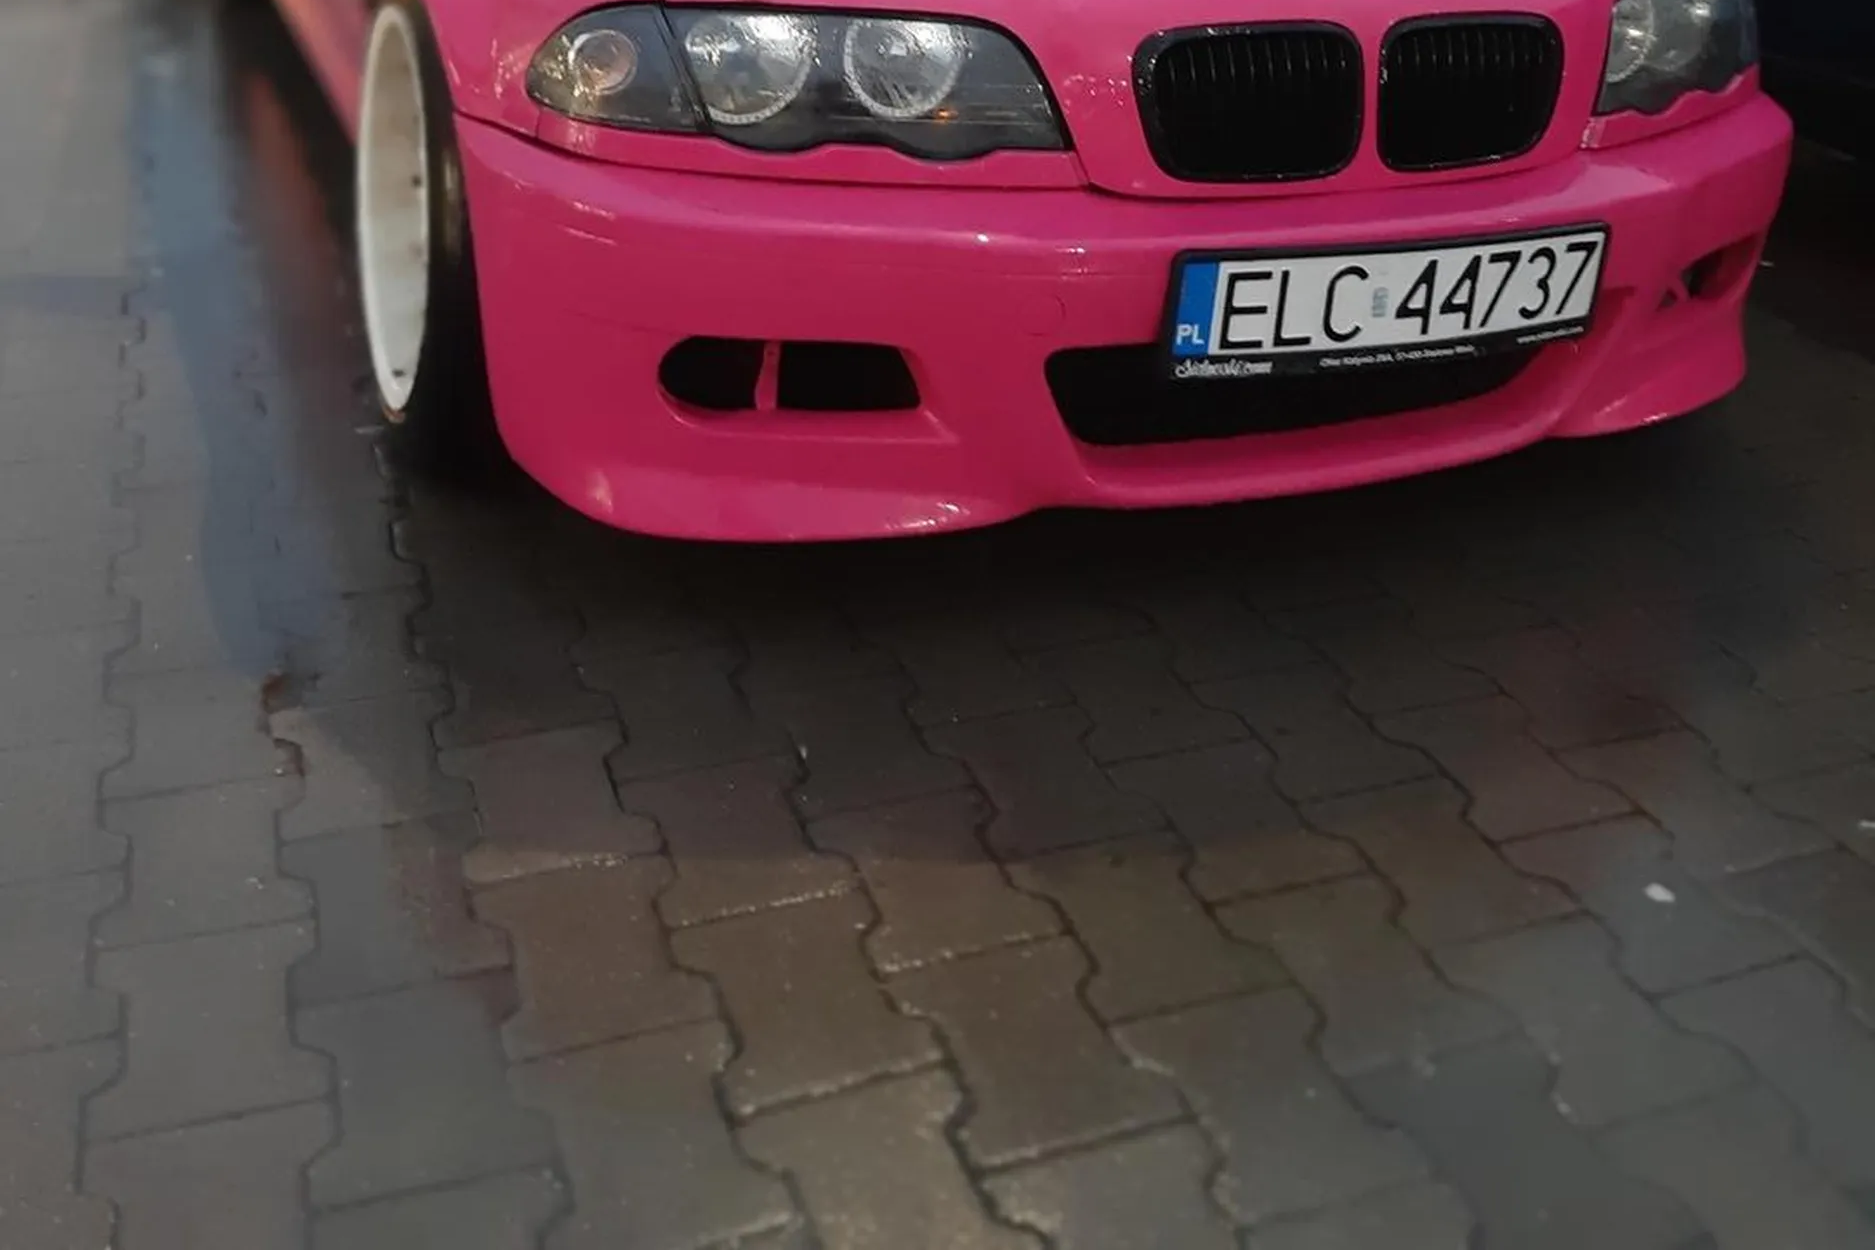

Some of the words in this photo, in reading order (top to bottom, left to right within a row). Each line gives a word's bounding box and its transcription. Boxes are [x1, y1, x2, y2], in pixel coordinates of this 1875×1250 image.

[1219, 265, 1369, 349] ELC
[1395, 241, 1599, 335] 44737
[1177, 324, 1205, 346] PL
